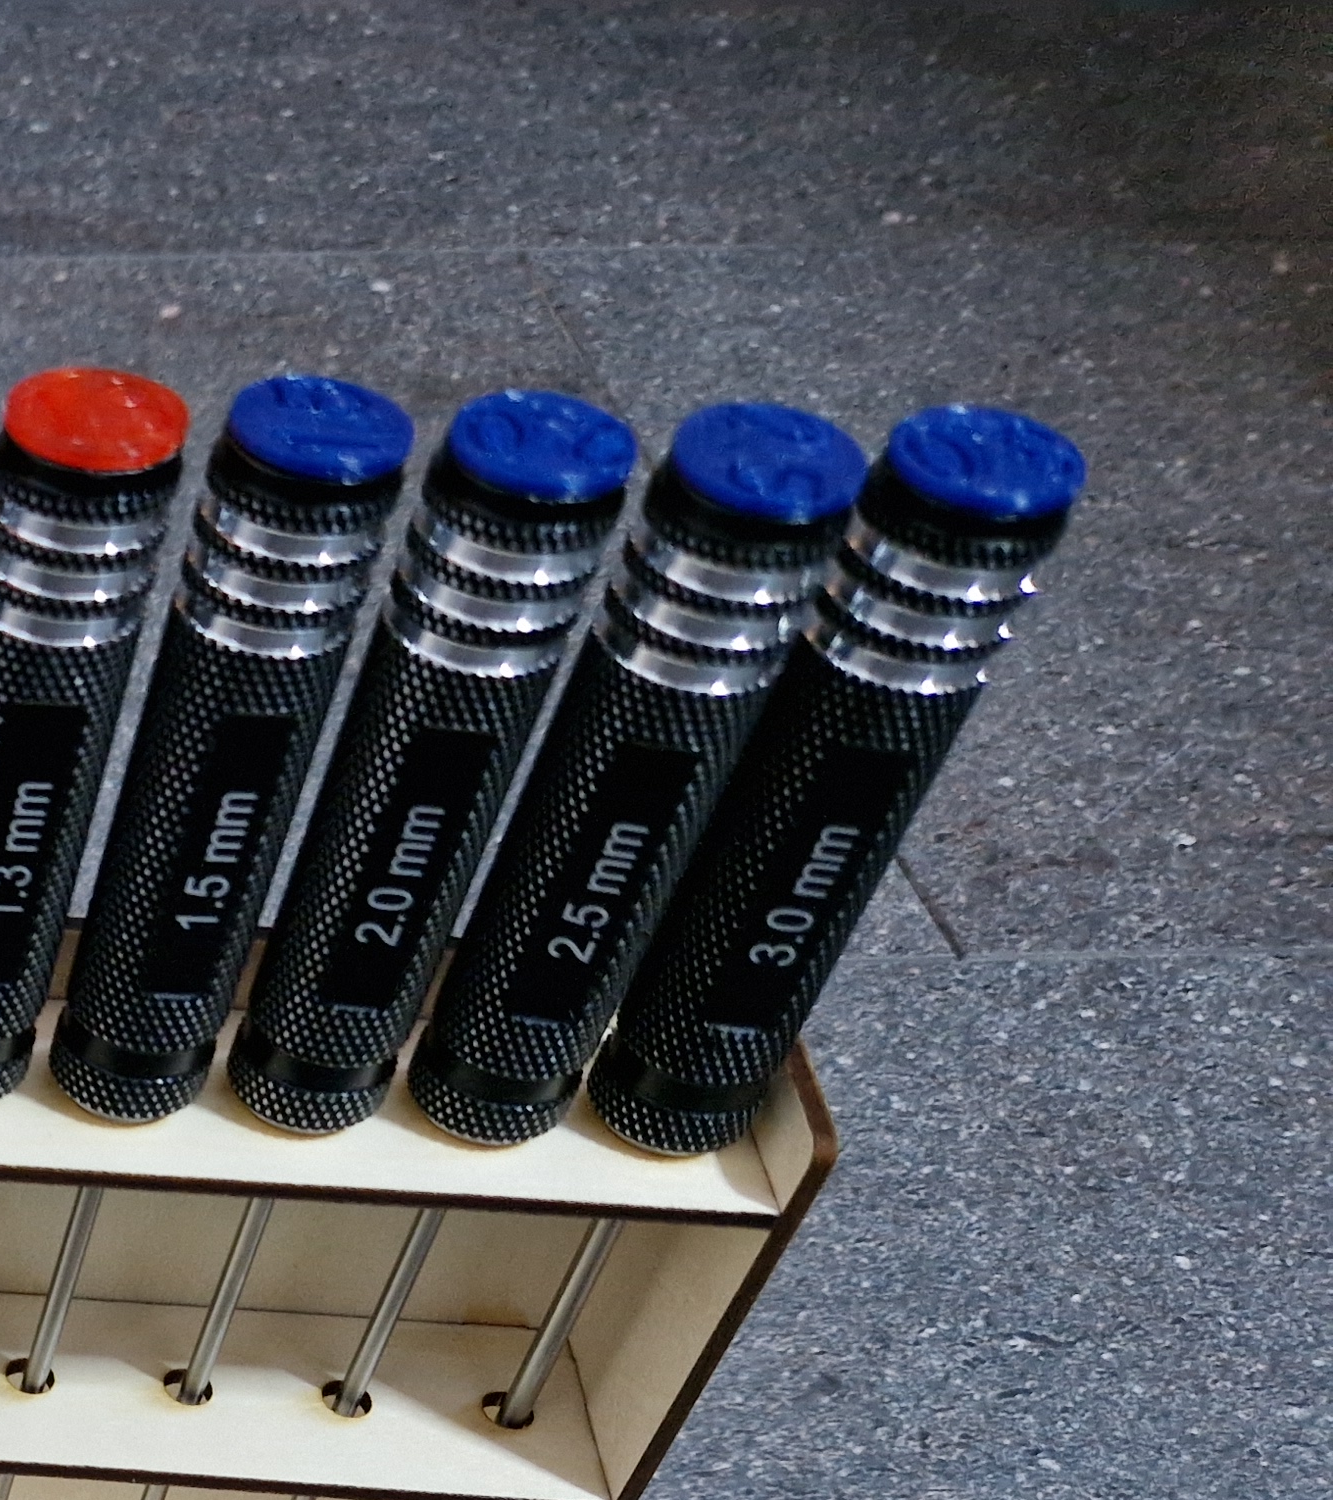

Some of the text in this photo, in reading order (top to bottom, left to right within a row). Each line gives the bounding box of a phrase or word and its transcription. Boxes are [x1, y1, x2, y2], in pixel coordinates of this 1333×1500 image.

[5, 781, 53, 852] mm
[175, 791, 259, 930] 1.5 mm
[355, 804, 446, 947] 2.0 mm
[547, 822, 650, 964] 2.5 mm
[749, 825, 860, 966] 3.0 mm
